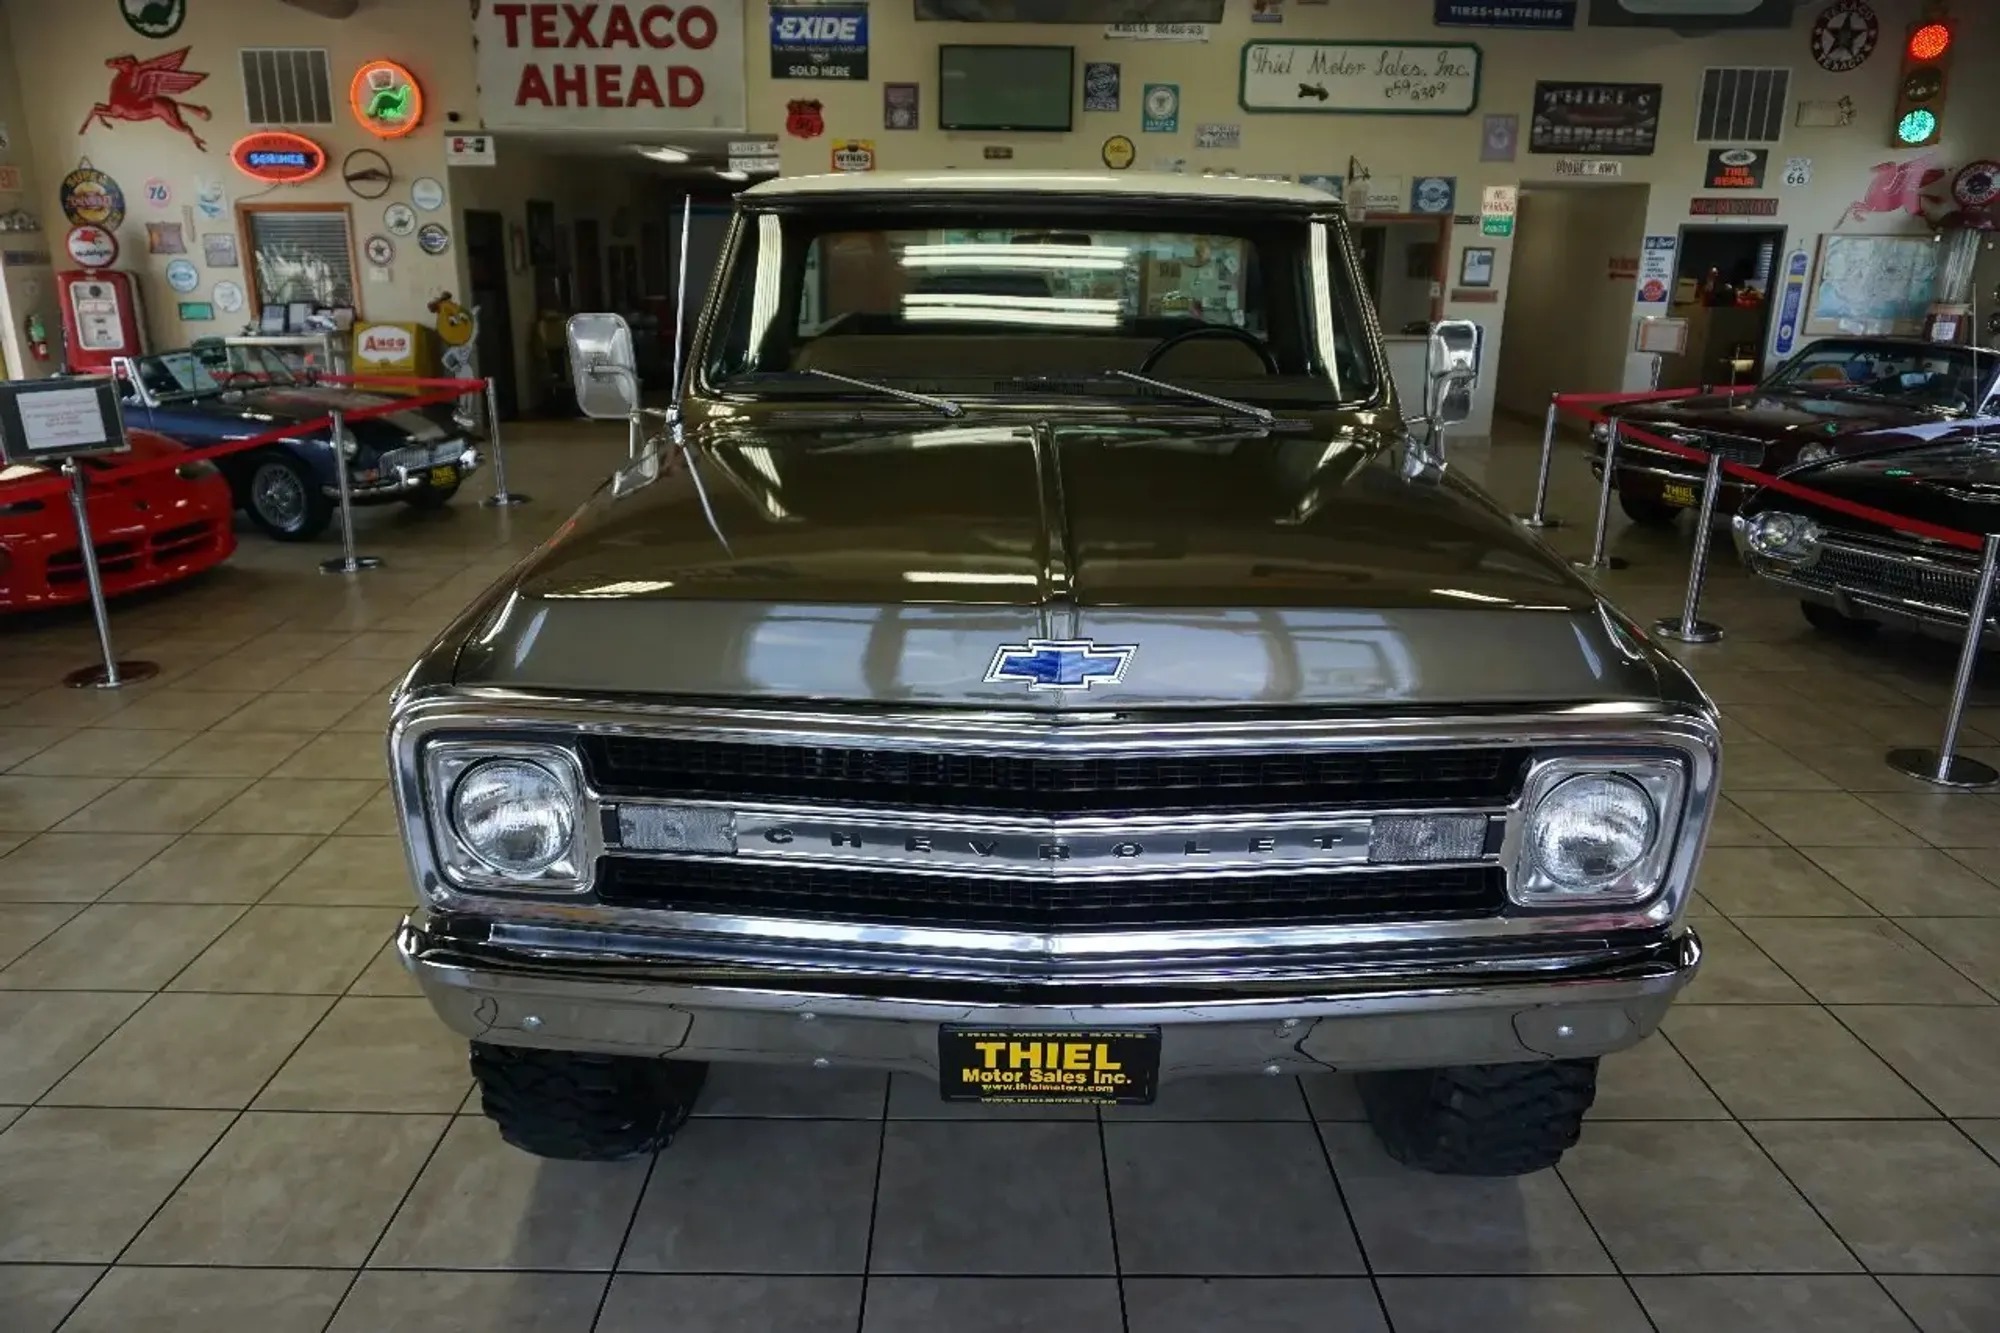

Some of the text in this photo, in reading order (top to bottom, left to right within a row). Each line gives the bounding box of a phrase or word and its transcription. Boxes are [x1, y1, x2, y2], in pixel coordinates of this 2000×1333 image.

[494, 4, 718, 50] TEXACO
[777, 17, 859, 40] EXIDE
[789, 66, 850, 76] SOLD HERE
[1307, 49, 1366, 75] Motor
[515, 63, 705, 108] AHEAD
[1724, 167, 1750, 176] TIRE
[1787, 173, 1805, 184] 66
[149, 186, 167, 200] 76
[1665, 484, 1694, 498] THIEL
[763, 826, 1342, 861] CHEVROLET
[975, 1042, 1122, 1070] THIEL
[963, 1068, 1132, 1085] Motor Sales Inc.
